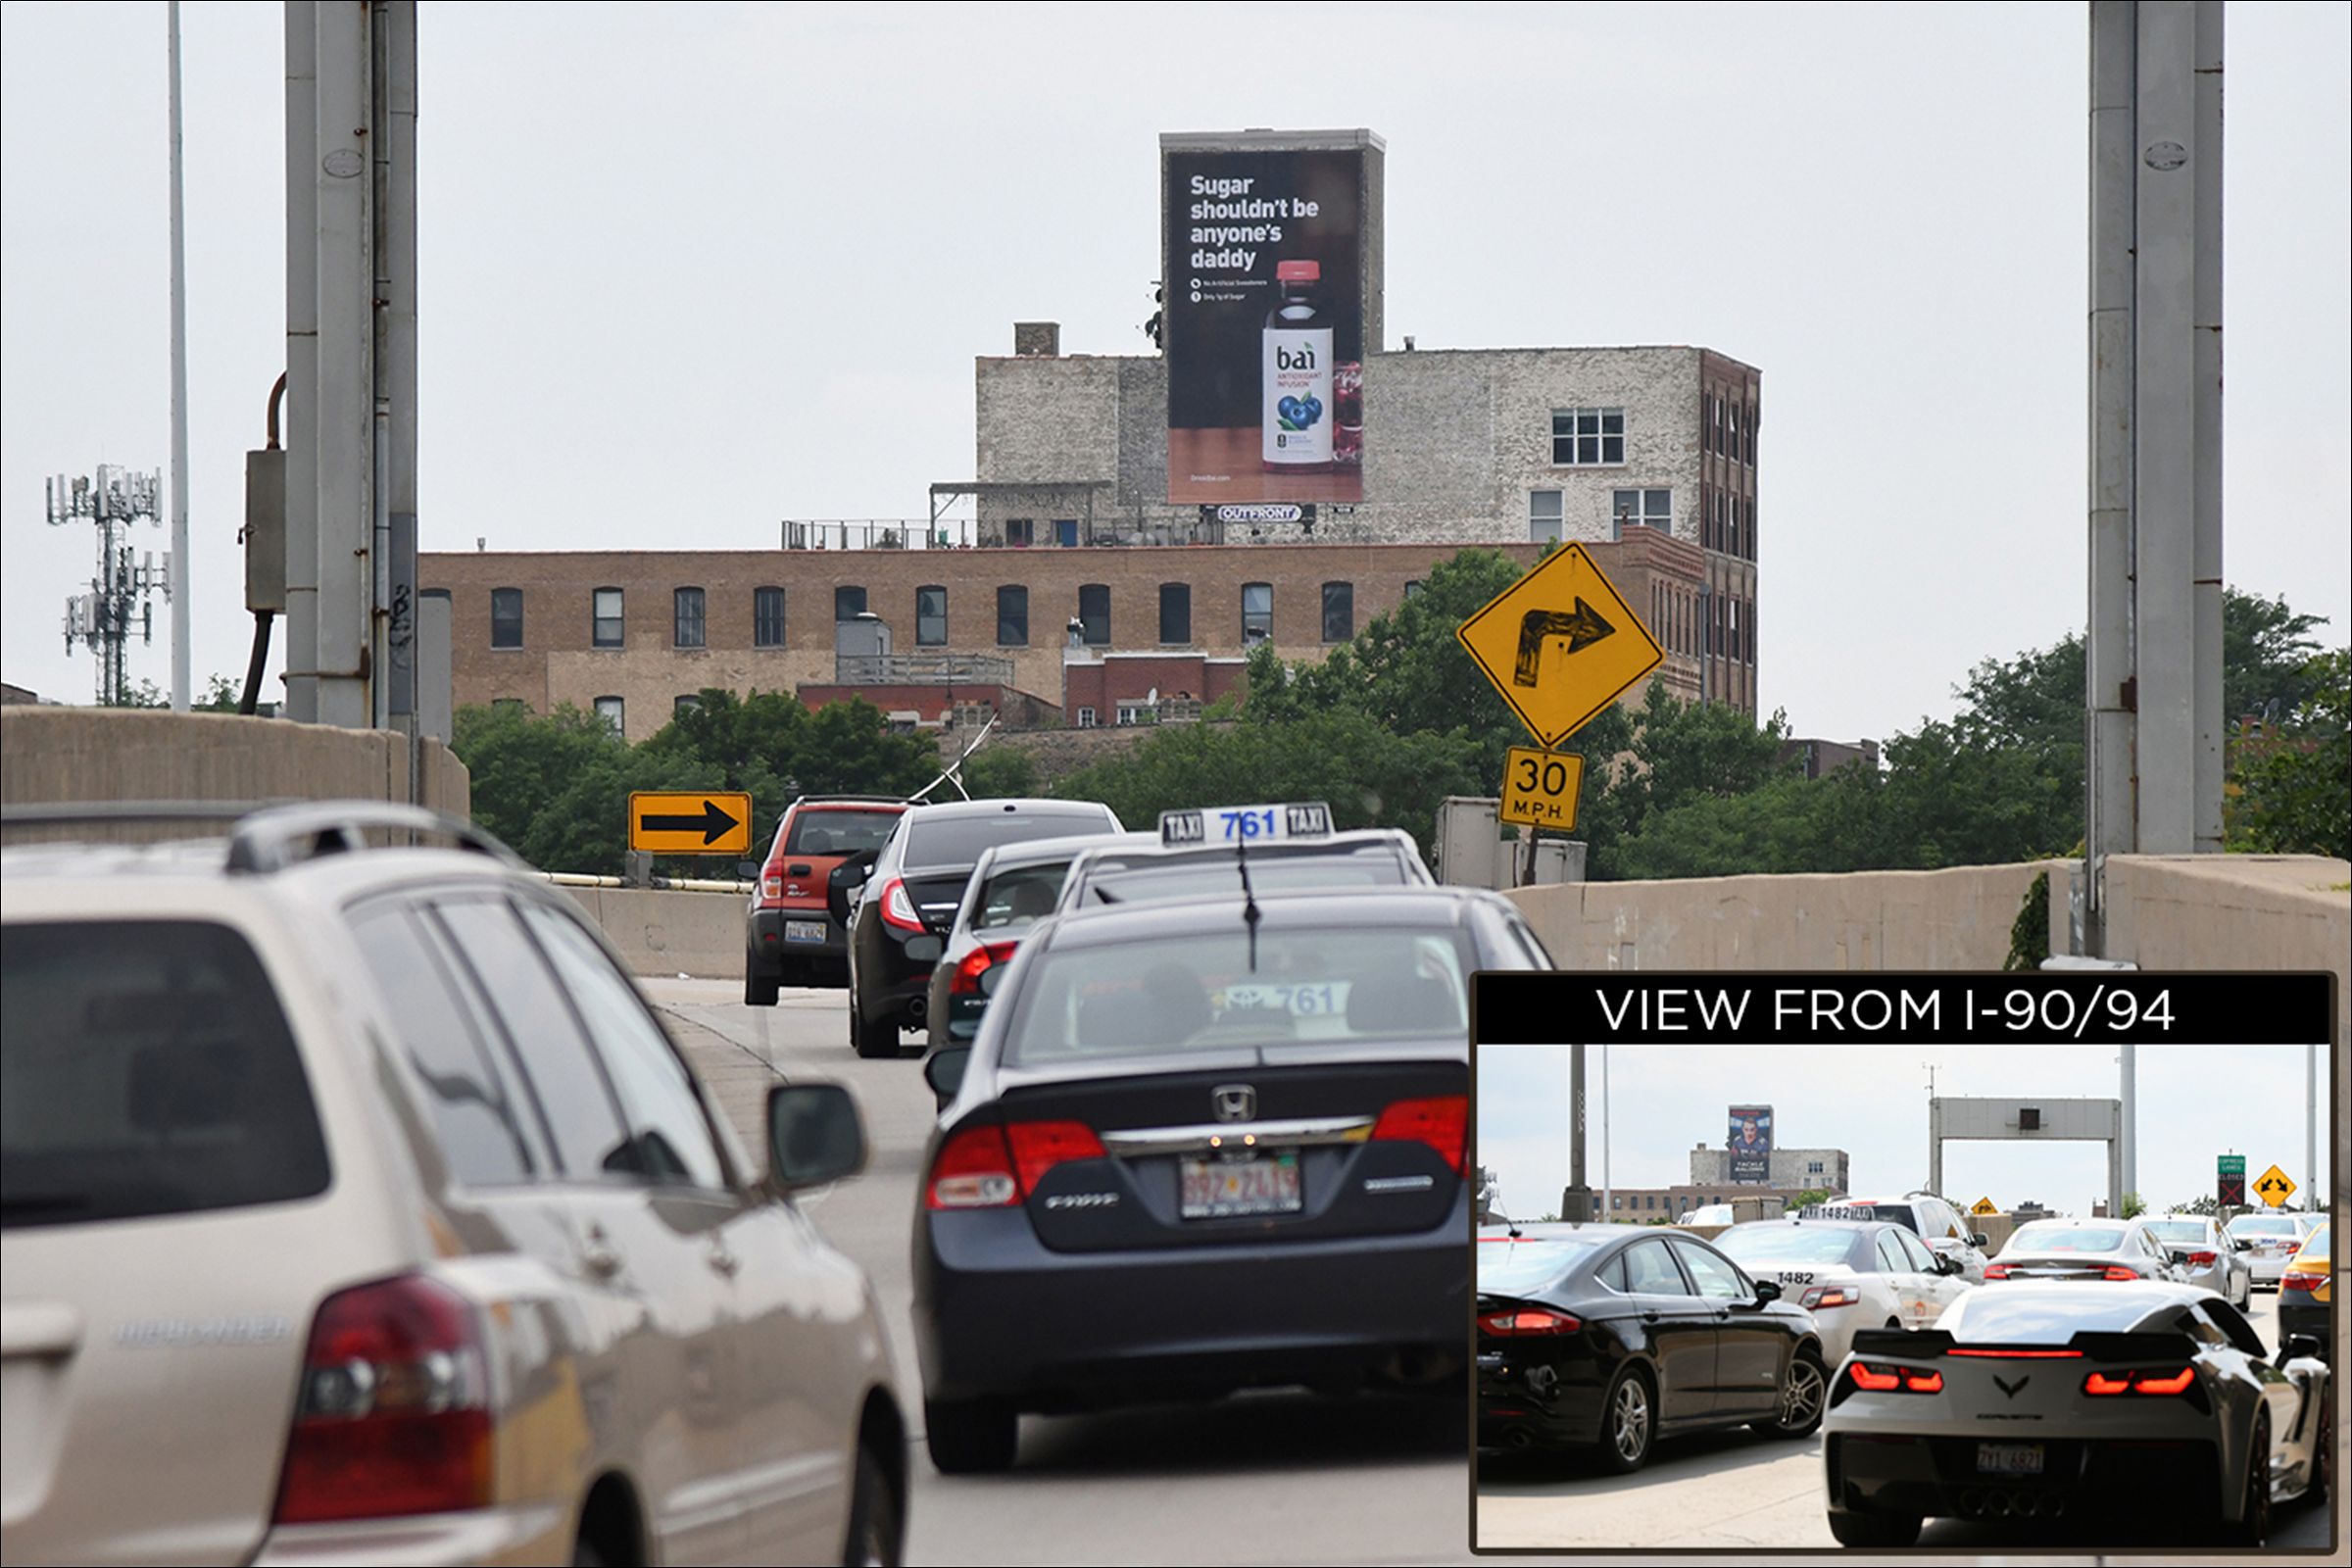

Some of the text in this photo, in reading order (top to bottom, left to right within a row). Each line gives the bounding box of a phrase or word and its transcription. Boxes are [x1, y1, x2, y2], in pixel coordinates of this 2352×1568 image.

[1191, 175, 1254, 198] Sugar
[1293, 197, 1319, 219] be
[1191, 248, 1256, 271] daddy
[1516, 759, 1567, 796] 30
[1513, 800, 1563, 819] M.P.H.
[1166, 808, 1324, 841] TAXI 761 TAXI
[1275, 985, 1334, 1014] 761
[1821, 1206, 1850, 1220] 1482
[1777, 1271, 1815, 1286] 1482
[1979, 1450, 2042, 1470] ZY1 6821
